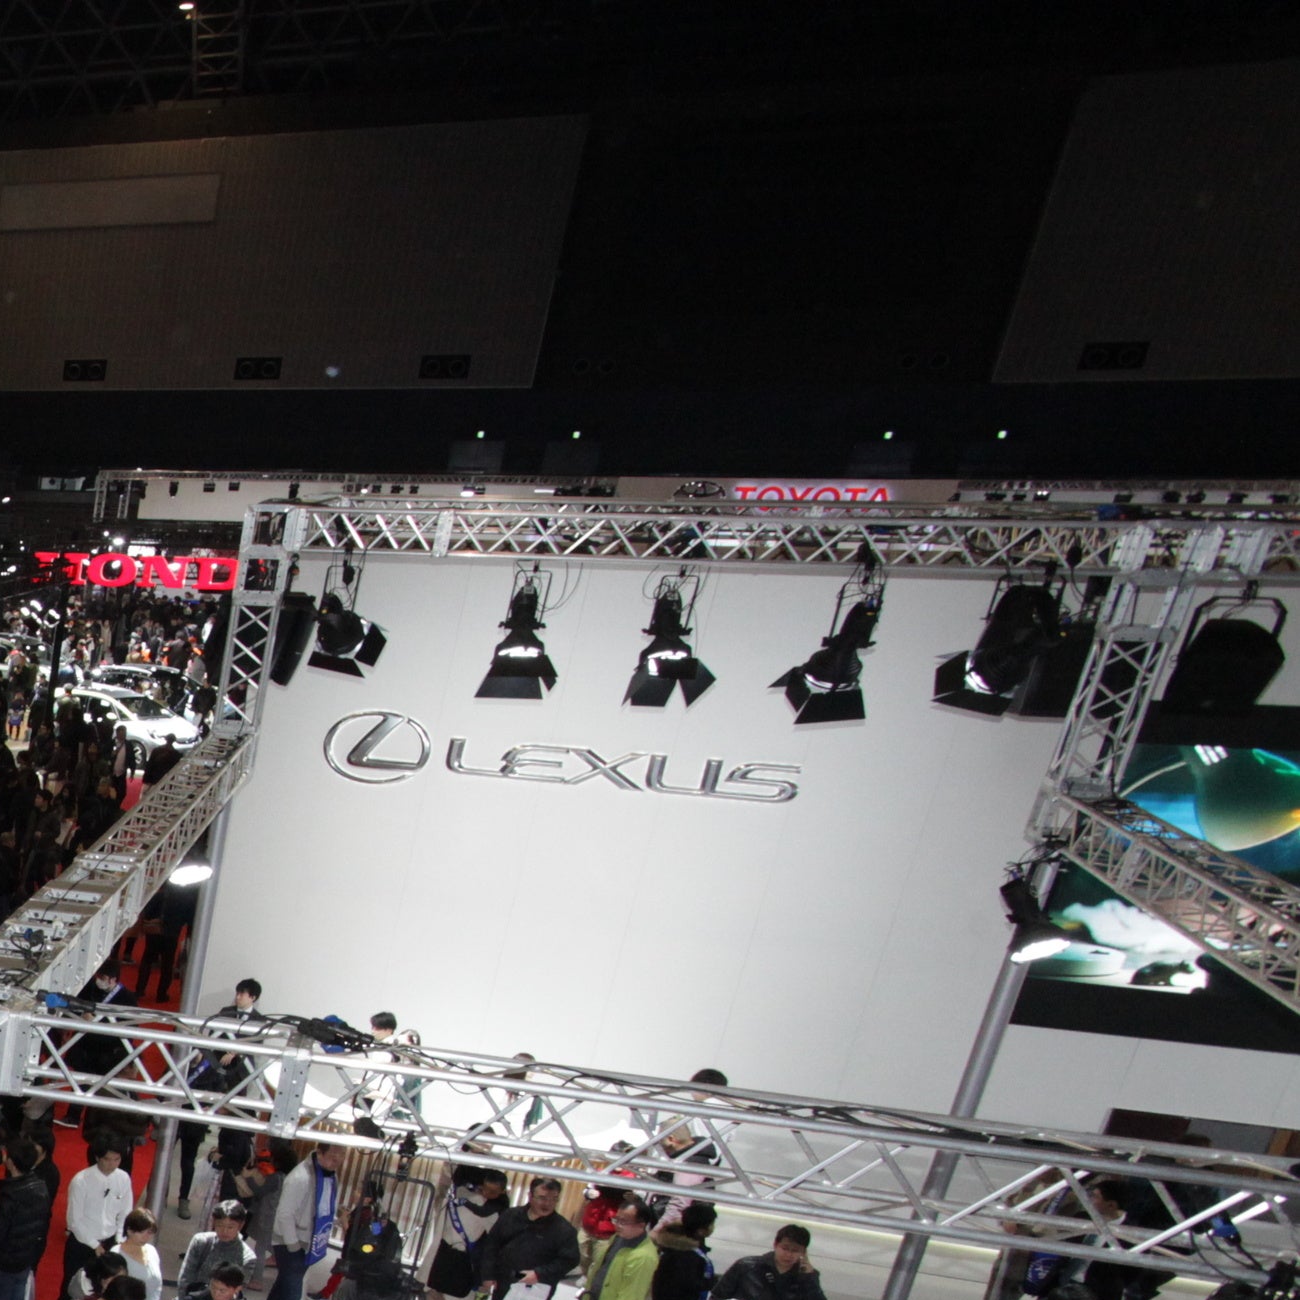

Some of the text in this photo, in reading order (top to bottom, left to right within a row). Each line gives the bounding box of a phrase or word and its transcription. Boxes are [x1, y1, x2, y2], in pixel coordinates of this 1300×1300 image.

[734, 486, 890, 511] TOYOTA
[32, 551, 240, 591] HOND
[446, 737, 802, 803] LEXUS
